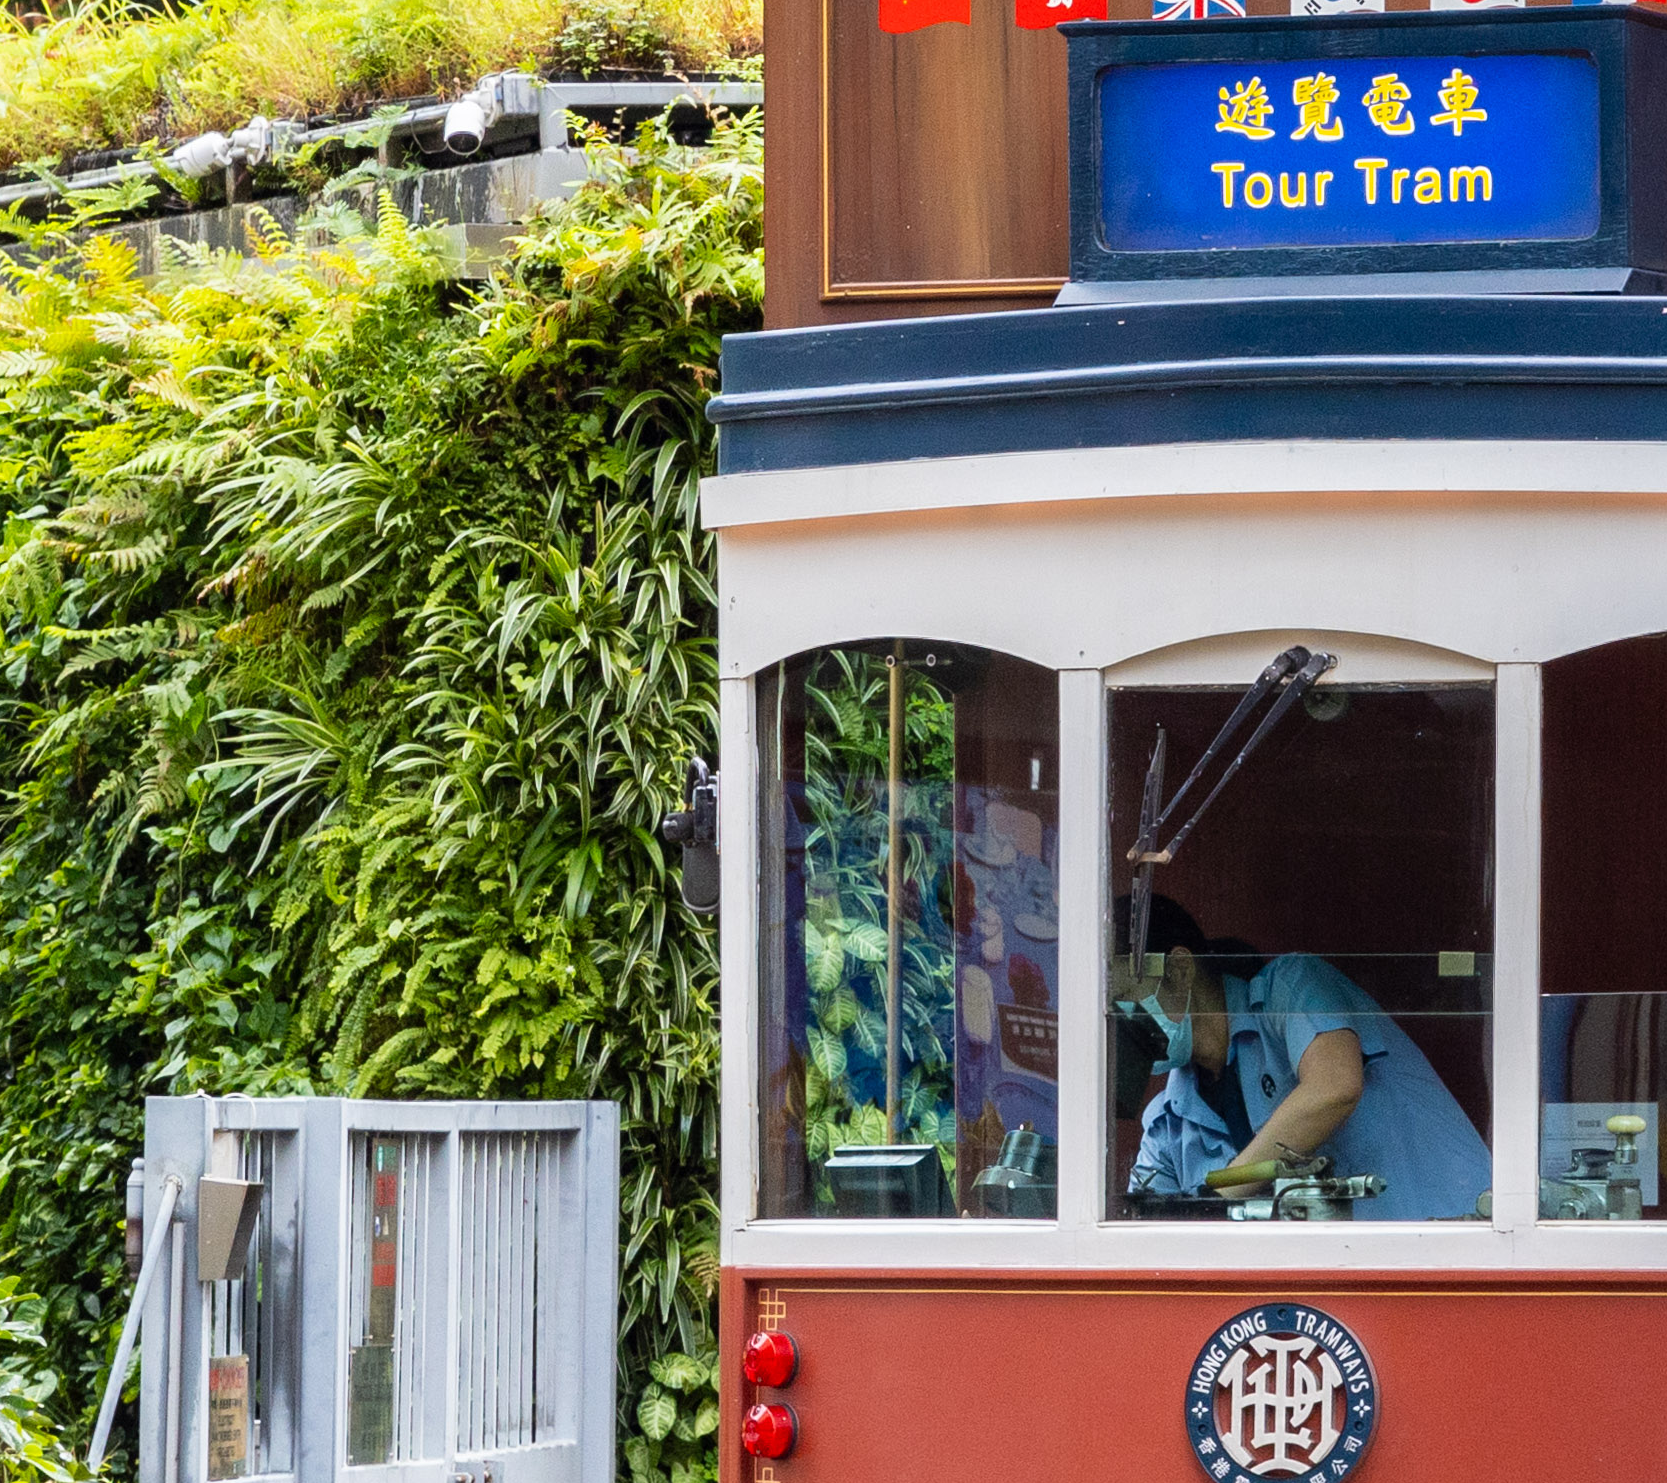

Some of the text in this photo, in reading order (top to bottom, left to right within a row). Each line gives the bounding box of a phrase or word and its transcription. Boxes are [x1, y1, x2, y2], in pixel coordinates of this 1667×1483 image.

[1215, 68, 1488, 141] 遊覽電車
[1211, 158, 1493, 208] Tour Tram
[1191, 1311, 1370, 1394] HONG KONG TRAMWAYS
